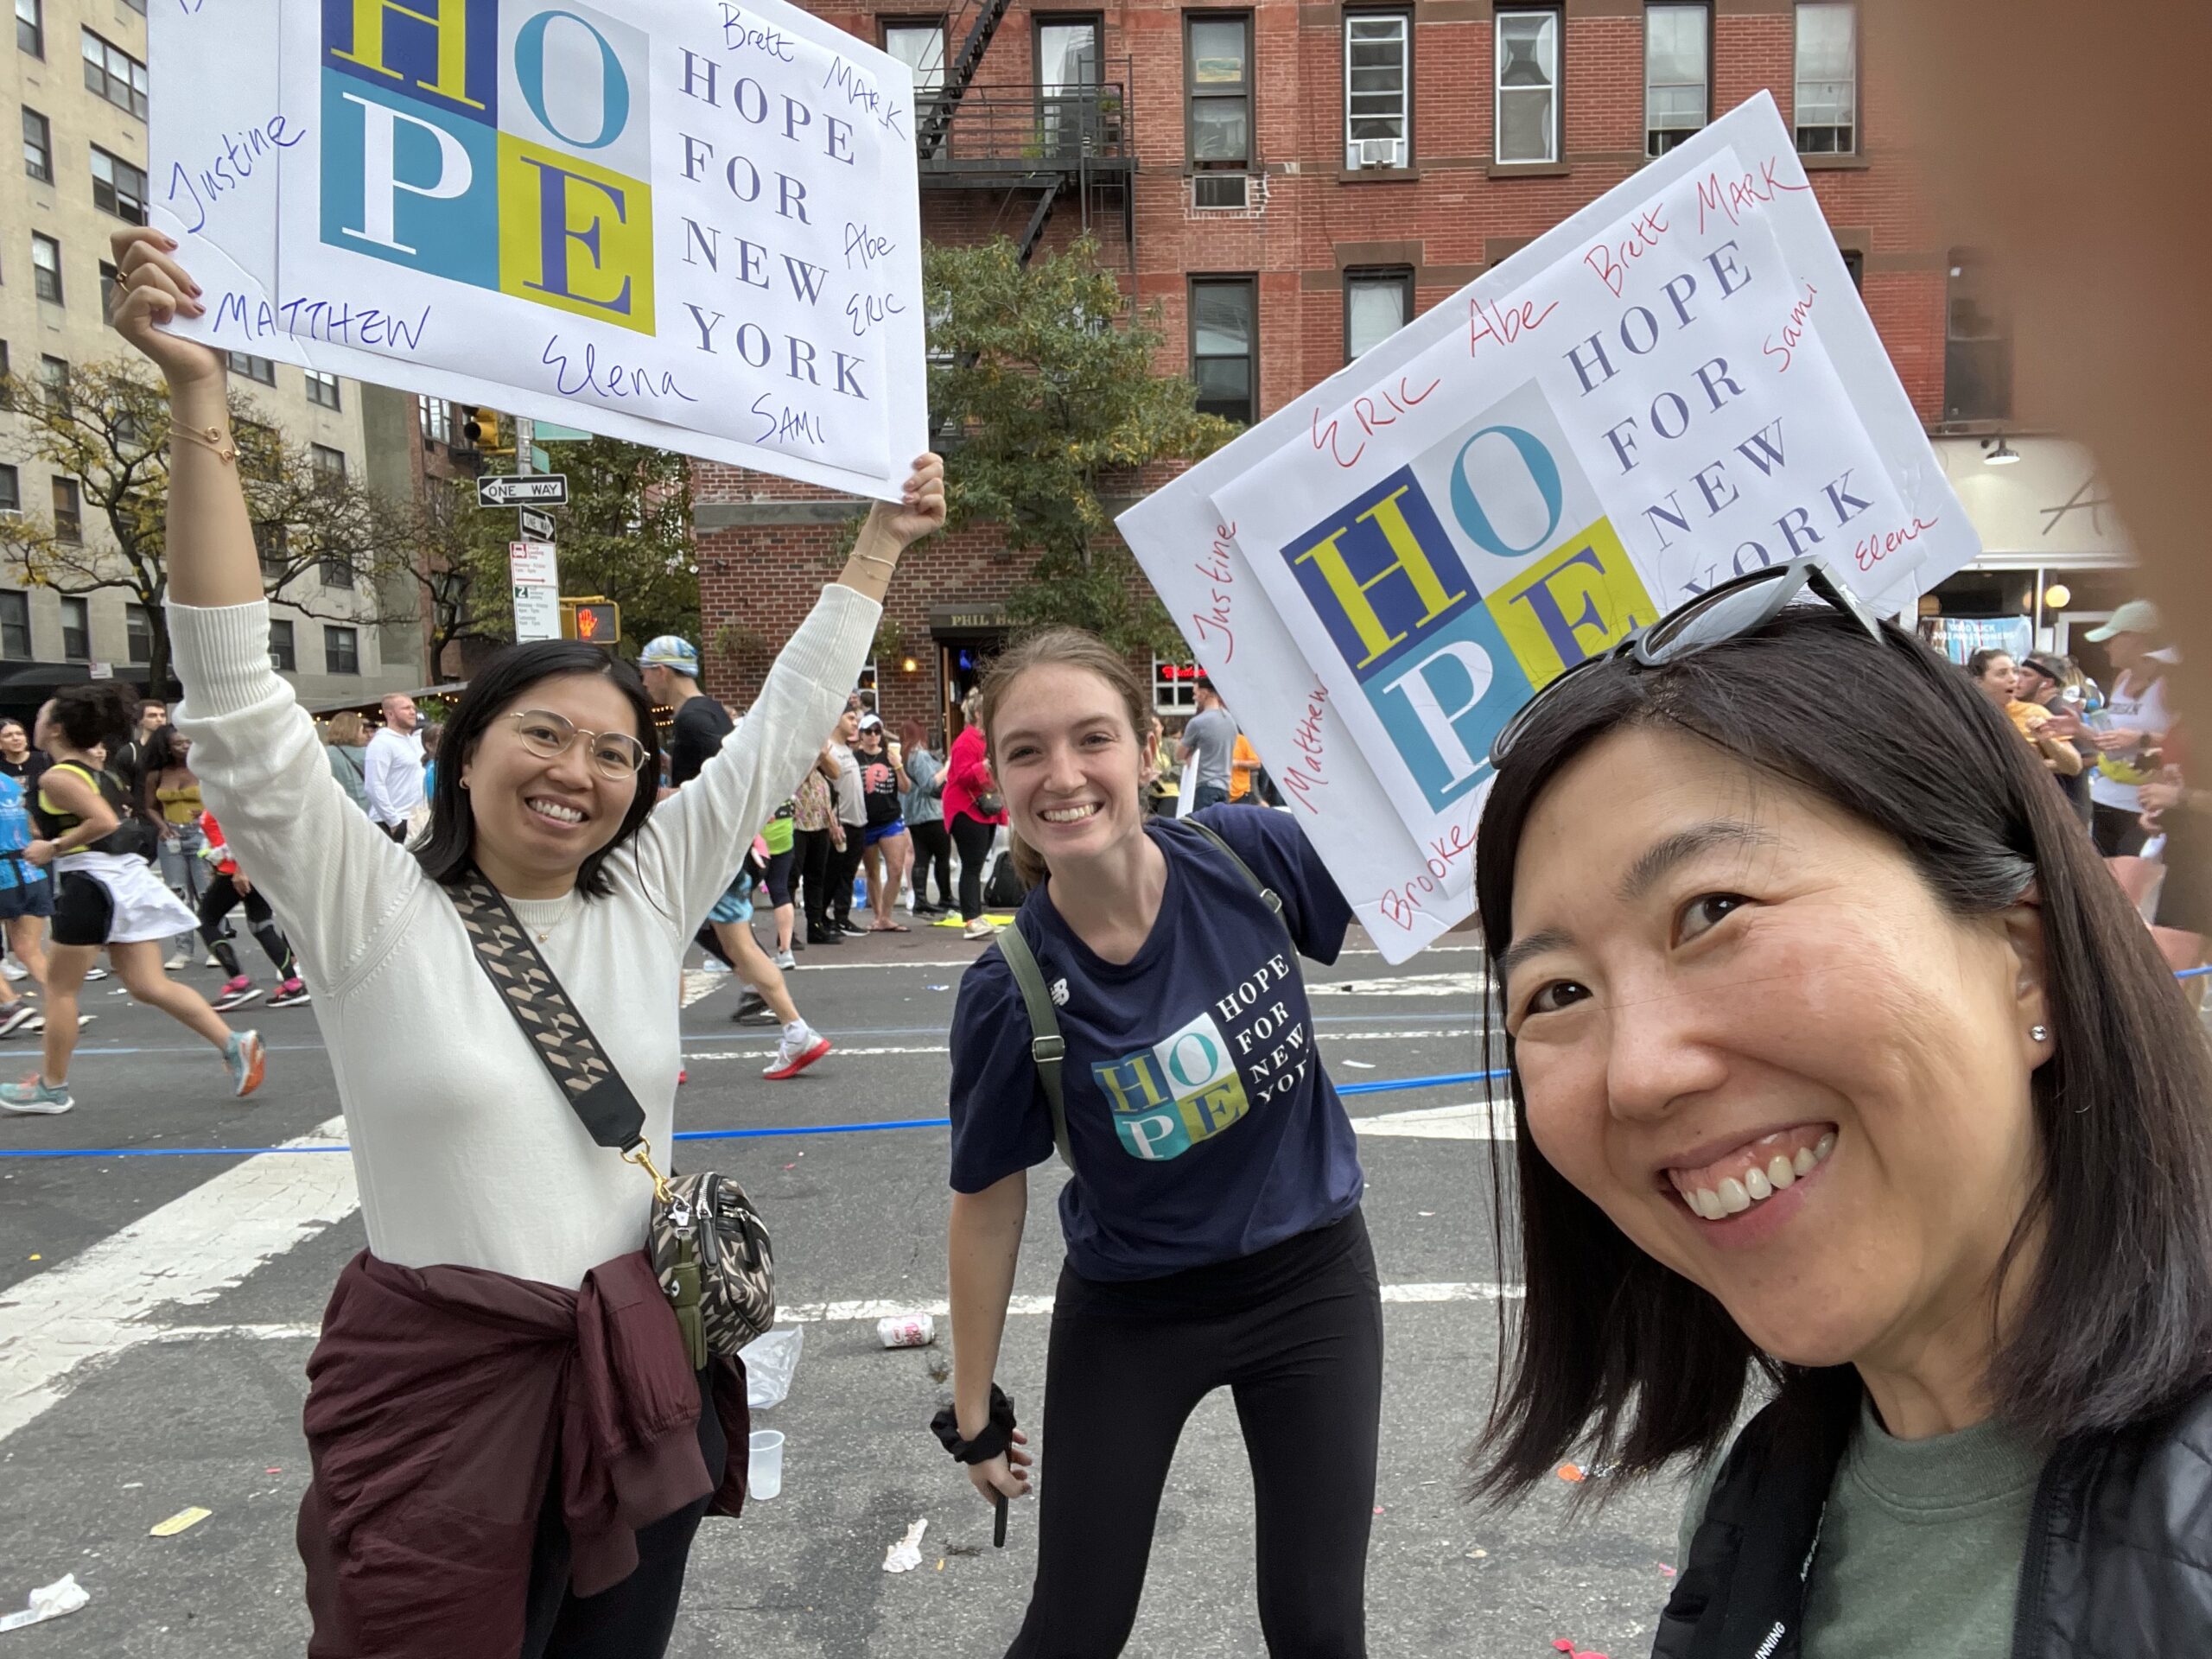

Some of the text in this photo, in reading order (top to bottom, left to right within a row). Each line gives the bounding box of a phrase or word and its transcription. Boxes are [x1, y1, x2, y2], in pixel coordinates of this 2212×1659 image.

[718, 3, 795, 62] Brett
[678, 46, 855, 166] HOPE
[823, 56, 906, 141] MARK
[168, 115, 306, 233] Justine
[678, 132, 812, 226] FOR
[1698, 156, 1812, 234] MARK
[681, 216, 830, 307] NEW
[844, 222, 896, 270] Abe
[1584, 203, 1669, 297] Brett
[213, 291, 431, 350] MATTHEW
[682, 302, 869, 400] YORK
[1468, 298, 1559, 358] Abe
[1561, 240, 1753, 397] HOPE
[1764, 276, 1818, 372] Sami
[543, 335, 698, 402] Elena
[1313, 377, 1440, 467] ERIC
[1602, 356, 1746, 475] FOR
[488, 485, 557, 496] ONE WAY
[1642, 416, 1787, 552] NEW
[1854, 517, 1938, 571] Elena
[951, 614, 989, 626] PHIL
[1192, 521, 1237, 664] Justine
[1282, 672, 1329, 814] Matthew
[1381, 823, 1477, 931] Brooke
[1216, 954, 1290, 1023] HOPE
[1236, 1001, 1290, 1055] FOR
[1249, 1023, 1306, 1084] NEW
